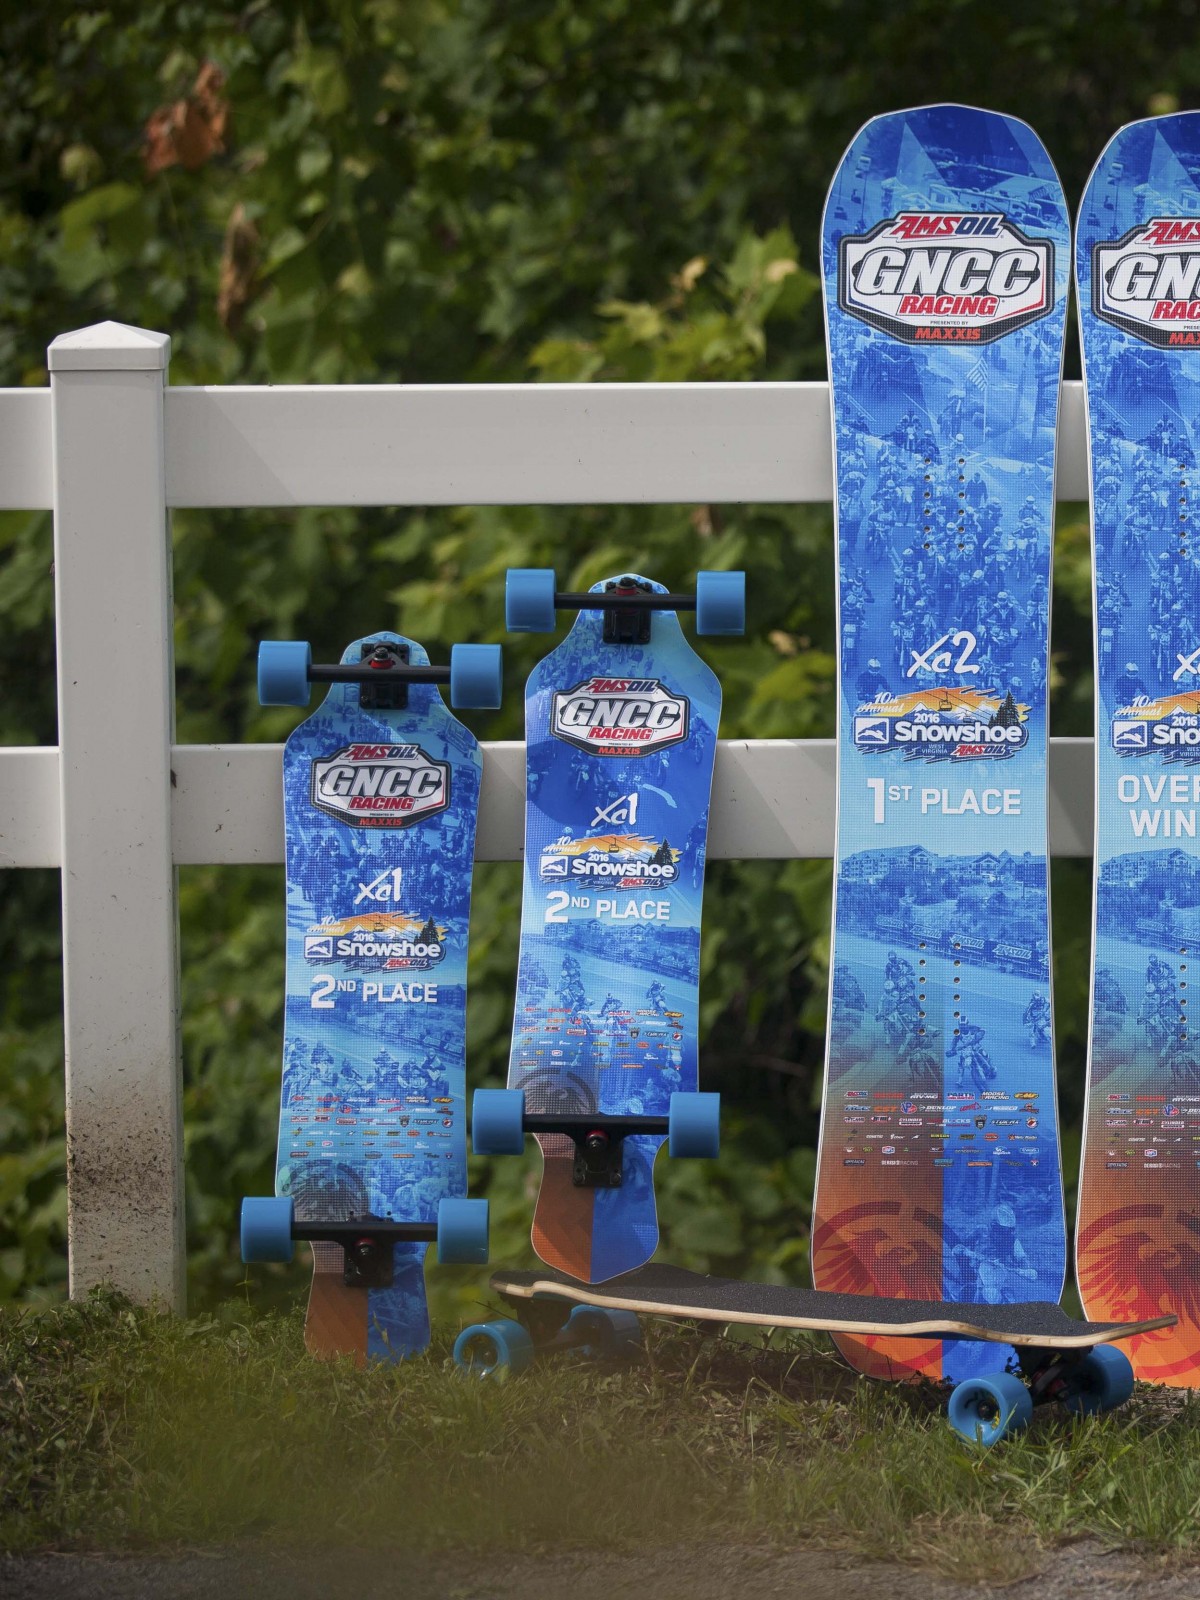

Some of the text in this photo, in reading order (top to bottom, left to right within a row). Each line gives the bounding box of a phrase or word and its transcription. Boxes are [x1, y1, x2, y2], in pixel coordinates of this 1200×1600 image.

[892, 216, 1001, 239] AMSOIL
[855, 247, 1039, 296] GNCC
[900, 296, 998, 315] RACING
[915, 328, 981, 340] MAXXIS
[585, 679, 659, 694] AMSOIL
[561, 697, 681, 728] GNCC
[914, 712, 940, 723] 2016
[1172, 715, 1198, 726] 2016
[588, 726, 654, 740] RACING
[894, 721, 1023, 742] Snowshoe
[347, 745, 416, 760] AMSOIL
[598, 747, 641, 757] MAXXIS
[951, 744, 1006, 757] AMSOIL
[320, 765, 441, 797] GNCC
[348, 797, 414, 811] RACING
[867, 778, 1020, 824] 1ST PLACE
[360, 818, 402, 826] MAXXIS
[588, 853, 609, 862] 2016
[571, 860, 675, 878] Snowshoe
[616, 877, 662, 887] AMSOIL
[544, 890, 671, 924] 2ND PLACE
[354, 933, 375, 942] 2016
[336, 940, 440, 957] Snowshoe
[384, 958, 429, 968] AMSOIL
[311, 974, 439, 1009] 2ND PLACE
